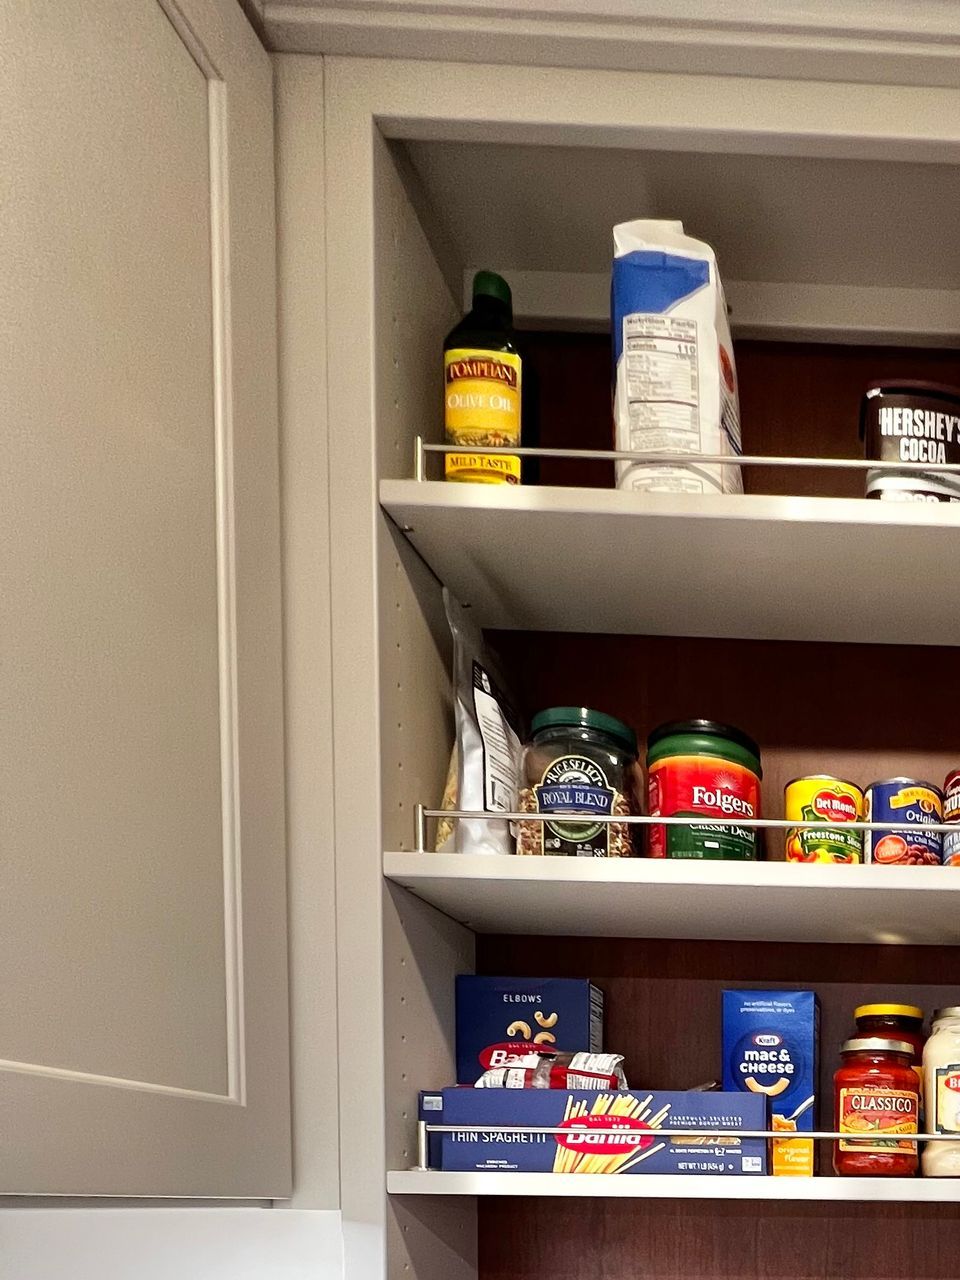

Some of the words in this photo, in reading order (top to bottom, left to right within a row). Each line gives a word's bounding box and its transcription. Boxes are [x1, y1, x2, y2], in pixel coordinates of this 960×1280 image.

[677, 344, 696, 354] 110
[447, 394, 483, 409] OLIVE
[900, 437, 946, 464] COCOA
[450, 457, 477, 468] MILD
[479, 457, 513, 470] TASTE
[543, 791, 573, 806] ROYAL
[575, 792, 608, 808] BLEND
[692, 786, 754, 817] Folgers
[816, 798, 832, 809] Del
[834, 799, 857, 816] Monte
[803, 831, 845, 842] Freestone
[503, 994, 543, 1004] ELBOWS
[758, 1036, 777, 1045] Kraft
[744, 1050, 778, 1061] mac
[778, 1049, 791, 1062] &
[851, 1095, 912, 1113] CLASSICO
[451, 1131, 479, 1143] THIN
[481, 1131, 547, 1144] SPAGHETTI
[566, 1124, 642, 1145] Barilla
